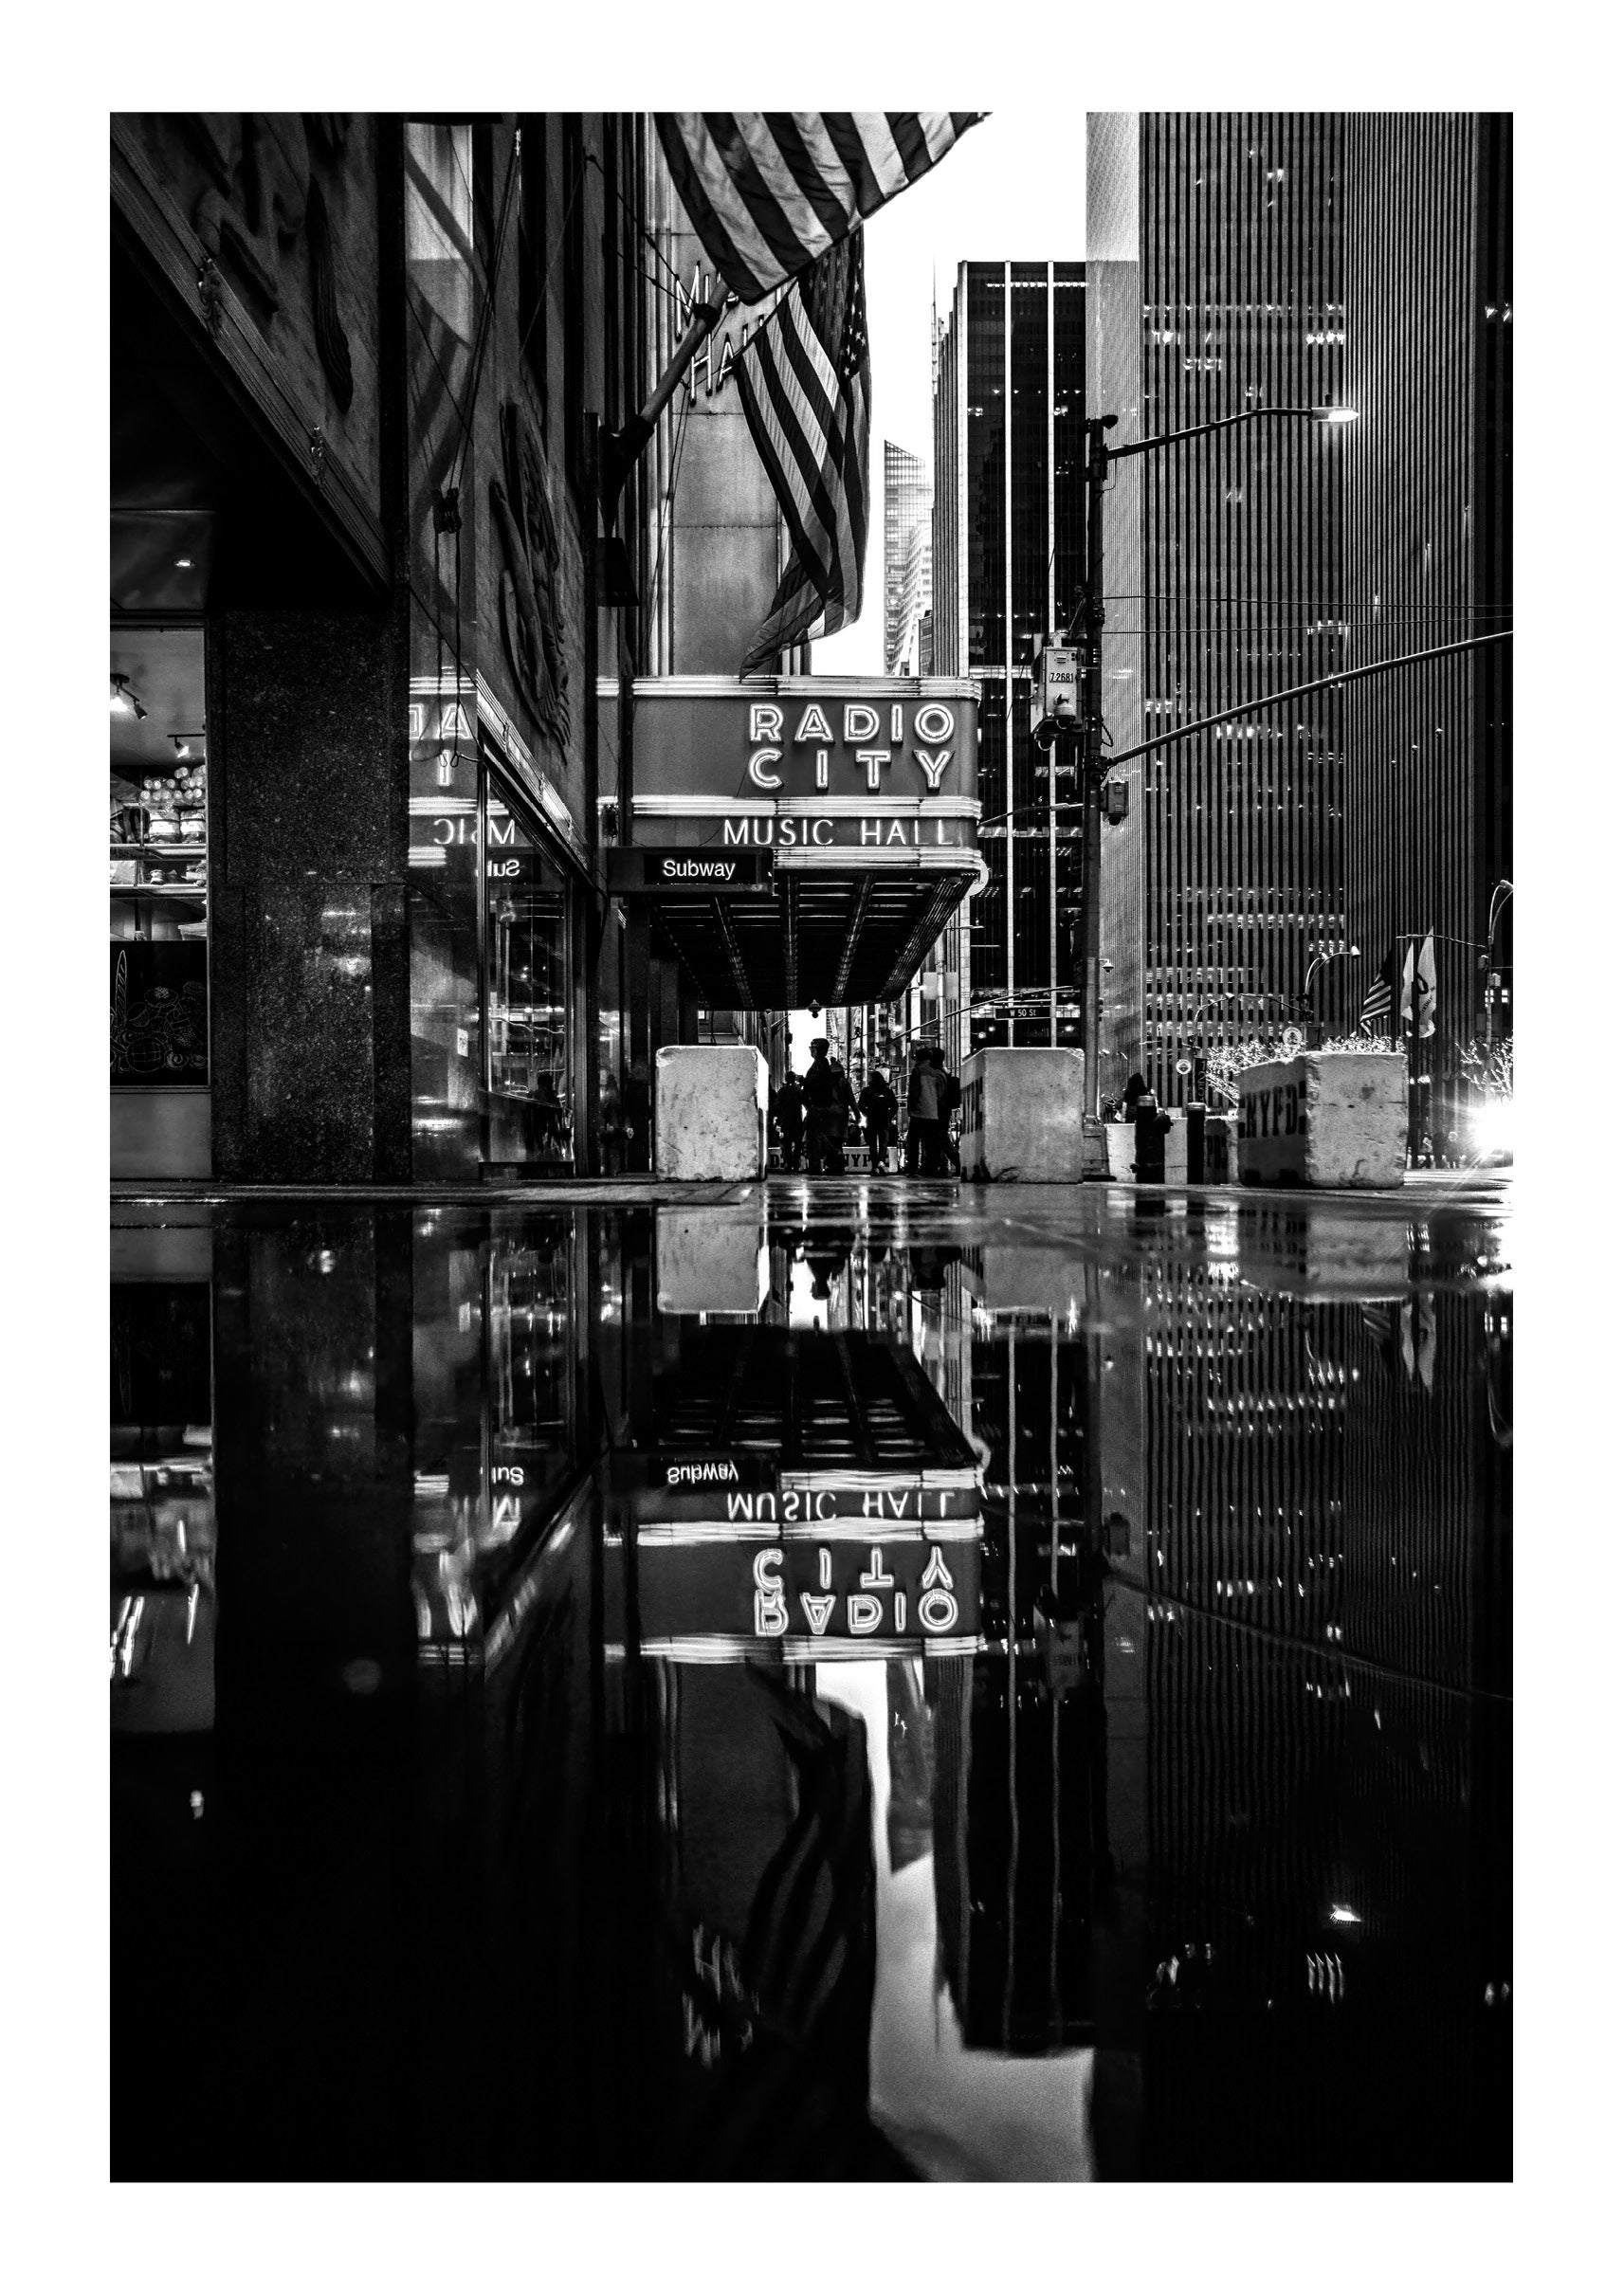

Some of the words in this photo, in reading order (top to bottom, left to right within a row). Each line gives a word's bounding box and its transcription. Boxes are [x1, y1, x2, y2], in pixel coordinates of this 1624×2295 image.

[749, 703, 955, 744] RADIO
[749, 748, 954, 790] CITY
[723, 819, 834, 846] MUSIC
[861, 819, 954, 846] HALL
[663, 858, 736, 881] Subway
[1018, 1009, 1027, 1017] 50
[1029, 1008, 1036, 1016] St
